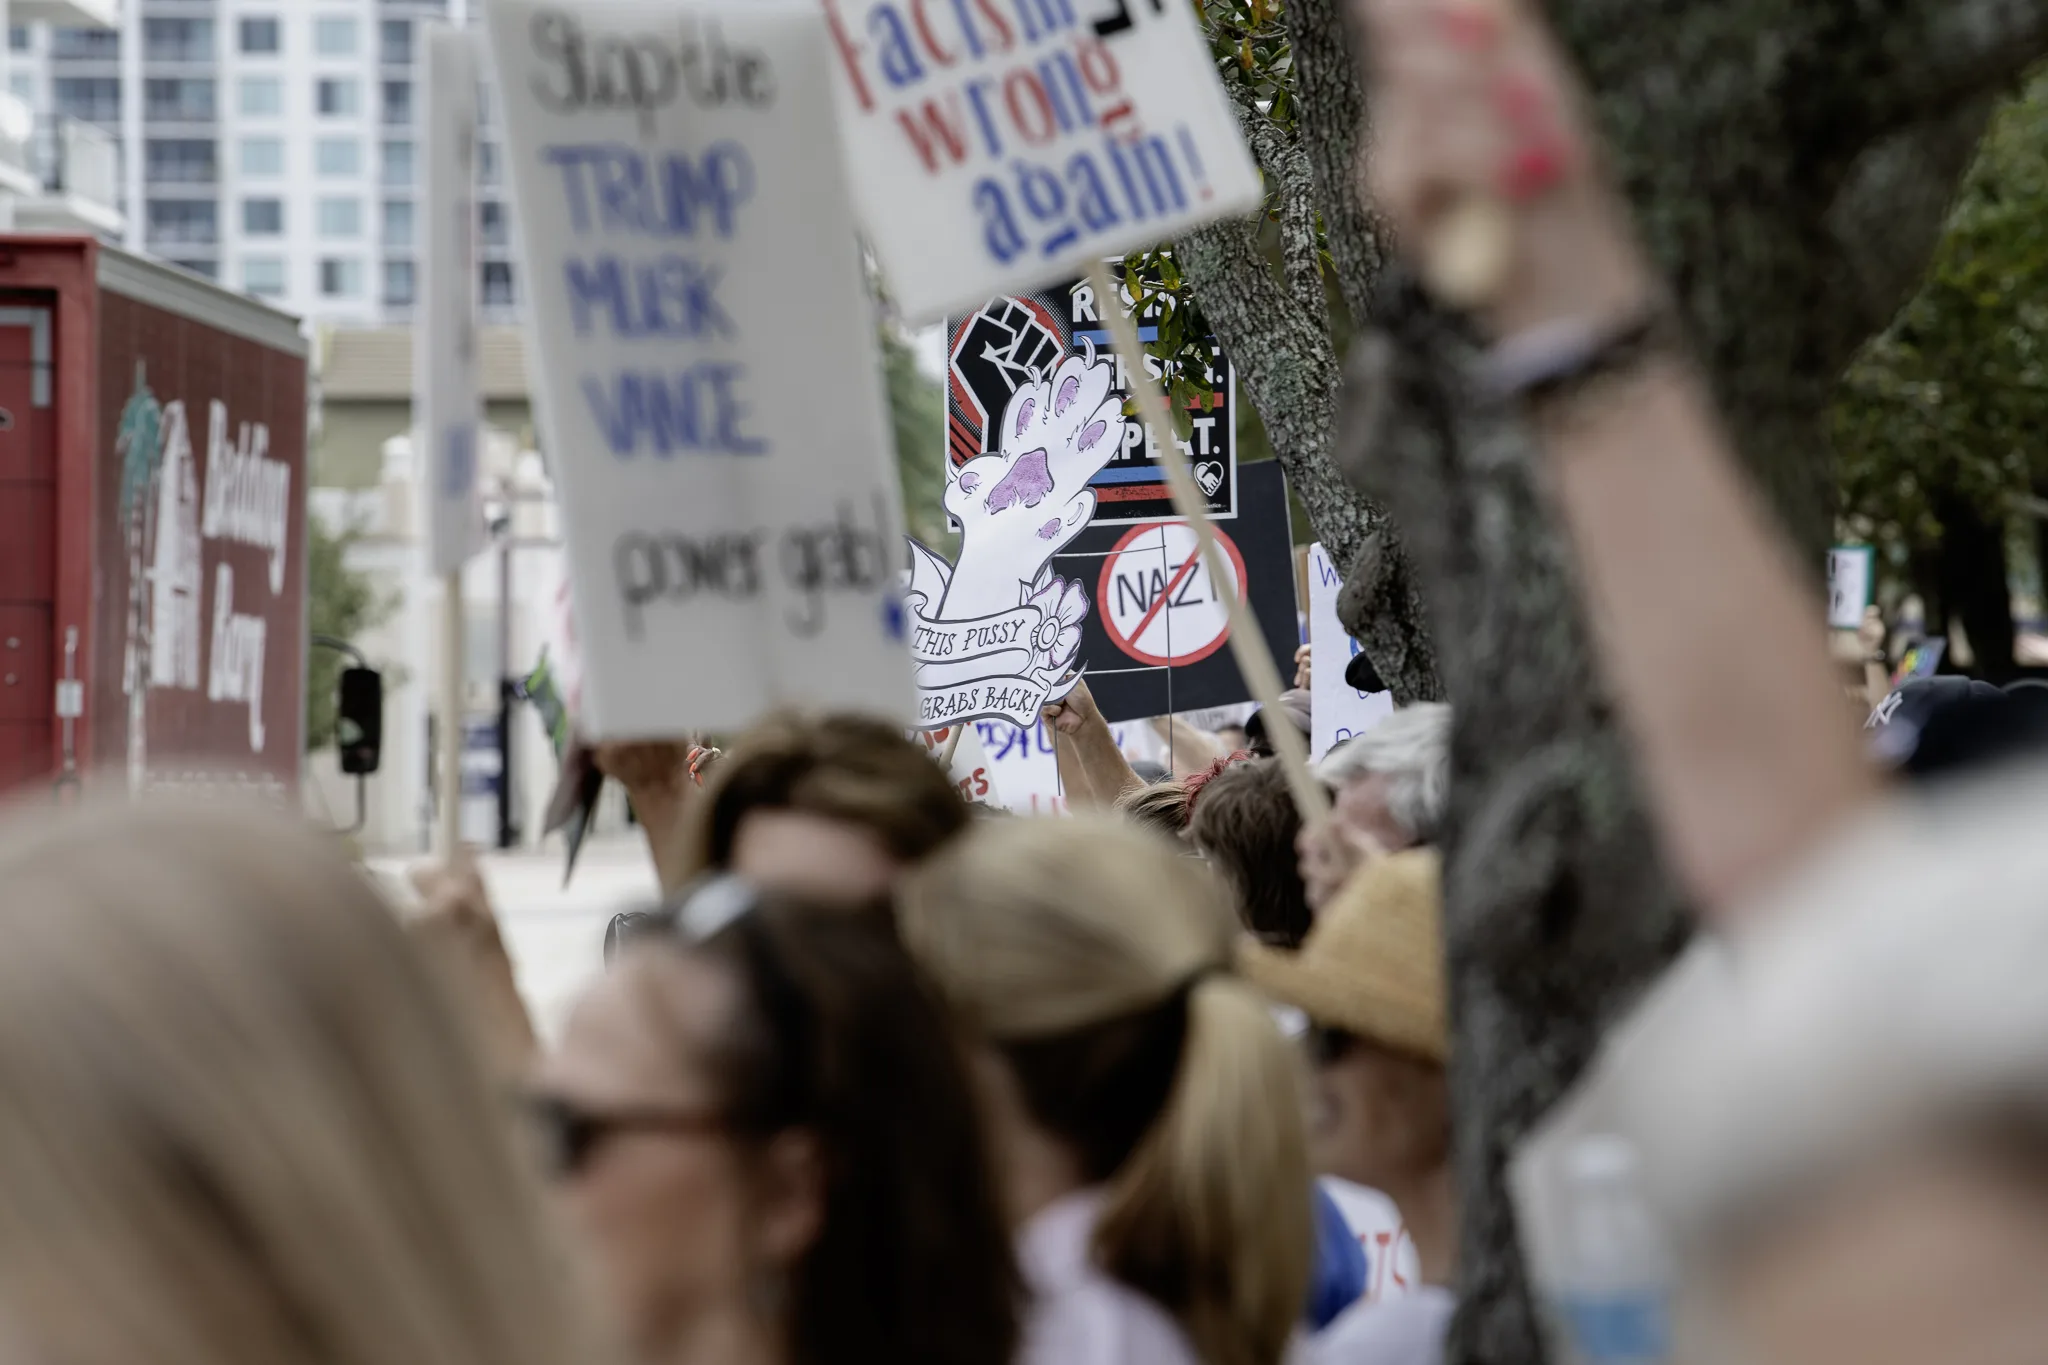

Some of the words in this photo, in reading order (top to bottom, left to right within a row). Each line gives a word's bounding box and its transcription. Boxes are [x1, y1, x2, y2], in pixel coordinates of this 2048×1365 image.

[894, 32, 1142, 176] wrong
[540, 140, 758, 240] TRUMP
[972, 122, 1214, 264] again!
[565, 255, 740, 342] MUSK
[912, 625, 957, 656] THIS
[962, 619, 1026, 651] PUSSY
[920, 688, 979, 720] GRABS
[982, 687, 1041, 717] BACK!
